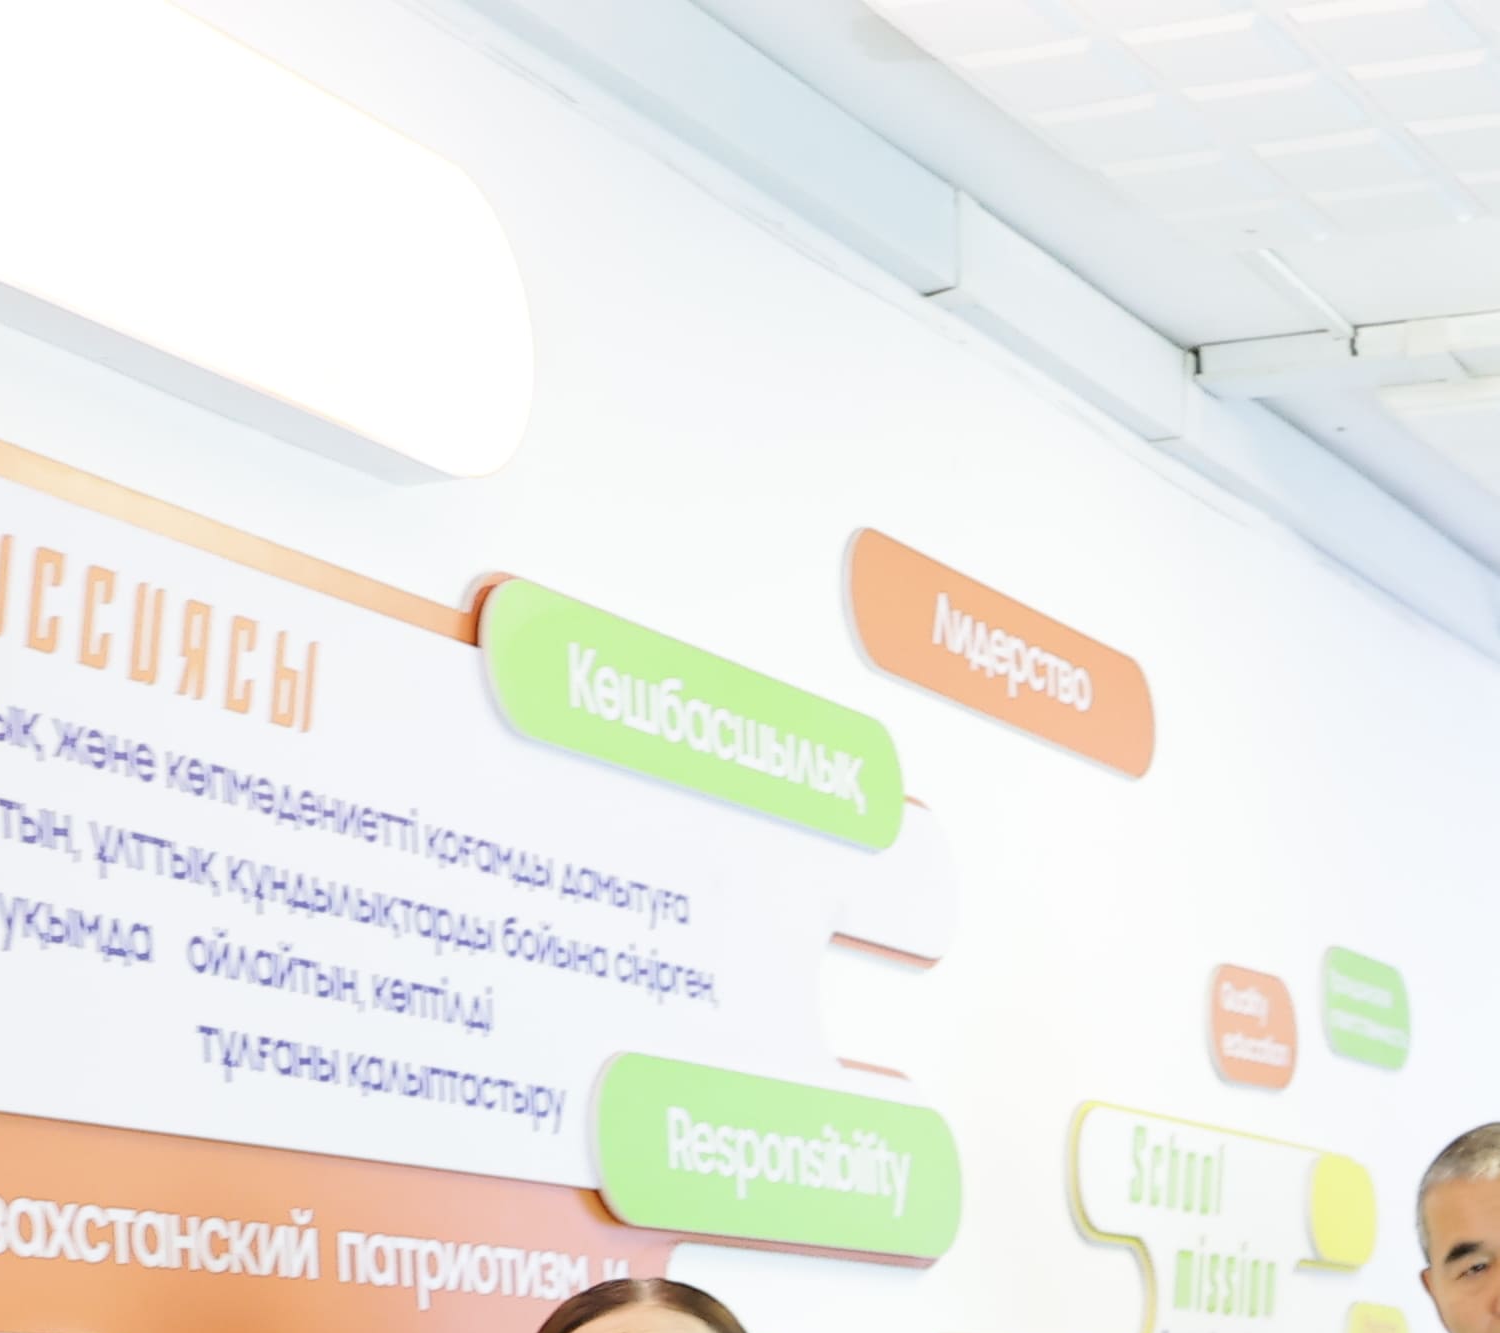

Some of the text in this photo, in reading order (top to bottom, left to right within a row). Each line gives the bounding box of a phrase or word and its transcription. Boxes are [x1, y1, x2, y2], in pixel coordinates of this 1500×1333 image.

[931, 592, 1094, 711] Лидерство
[566, 641, 868, 814] Көшбасшылық
[51, 718, 156, 783] және
[165, 751, 420, 854] көпмәдениетті
[425, 823, 554, 892] қоғамды
[559, 862, 690, 930] дамытуға
[88, 820, 221, 897] ұлттық
[225, 854, 497, 956] құндылықтарды
[501, 916, 608, 978] бойына
[370, 976, 495, 1037] көптілді
[196, 1024, 567, 1136] тұлғаны қалыптастыру
[665, 1105, 913, 1218] Responsibility
[336, 1226, 590, 1311] патриотизм
